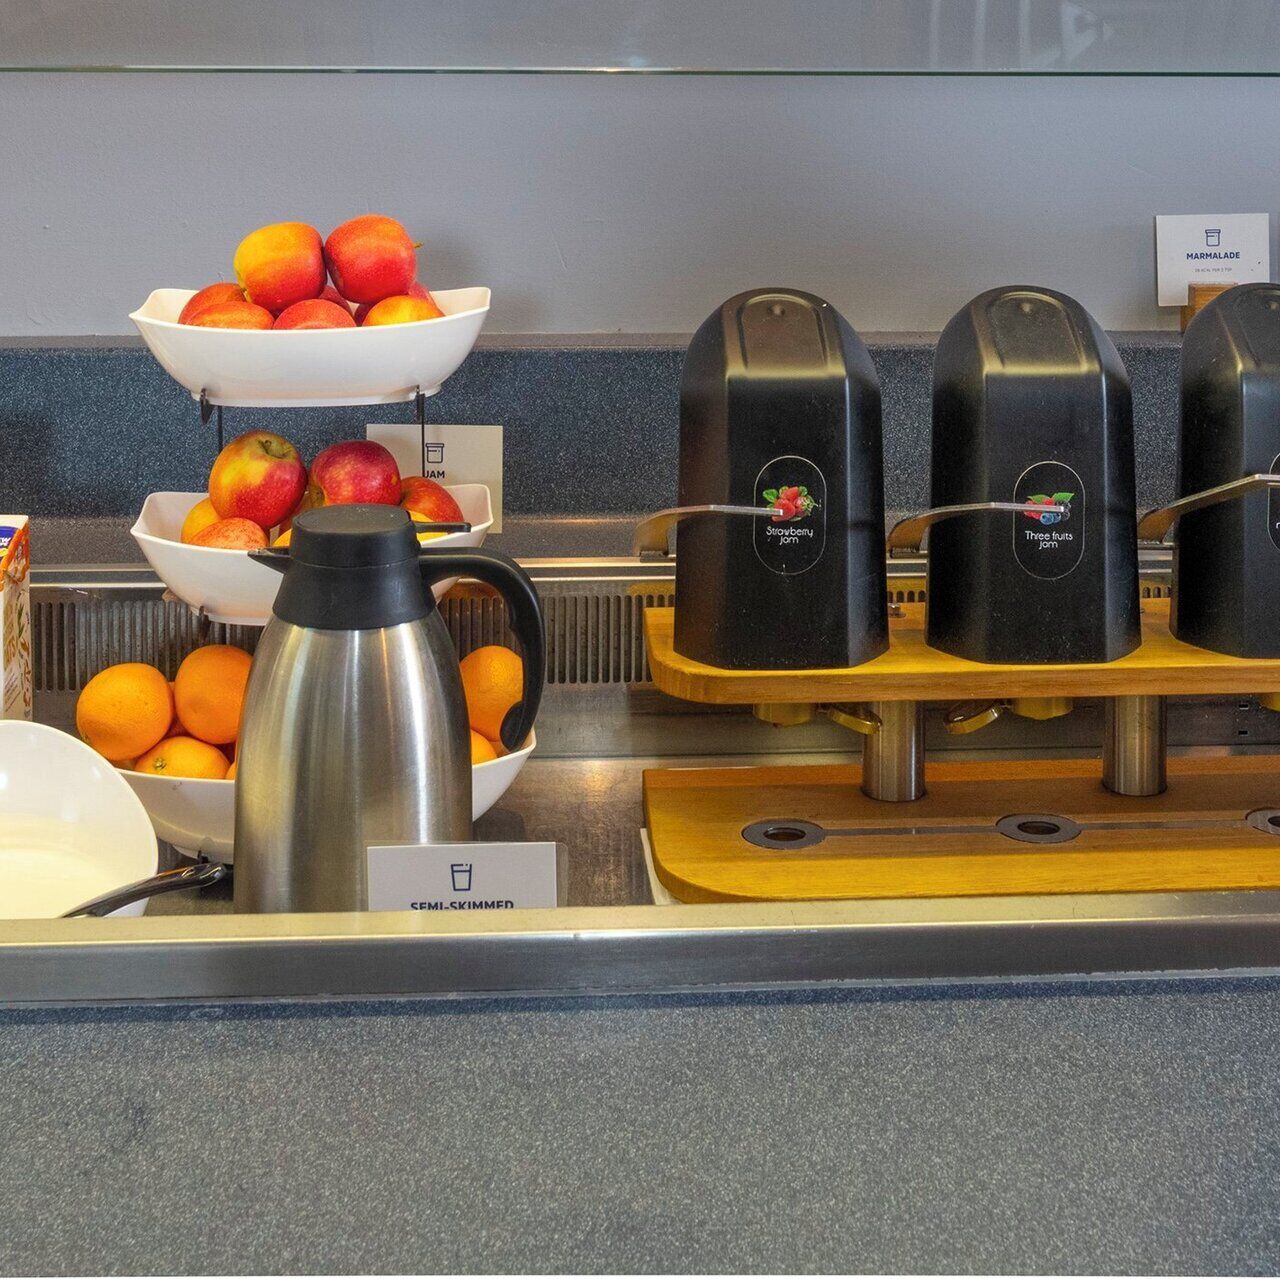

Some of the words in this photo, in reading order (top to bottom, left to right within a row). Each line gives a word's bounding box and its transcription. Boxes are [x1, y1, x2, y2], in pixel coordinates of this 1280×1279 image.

[1186, 251, 1241, 260] MARMALADE
[766, 526, 814, 538] Strawberry
[1024, 530, 1051, 540] Three
[1052, 531, 1074, 541] fruits
